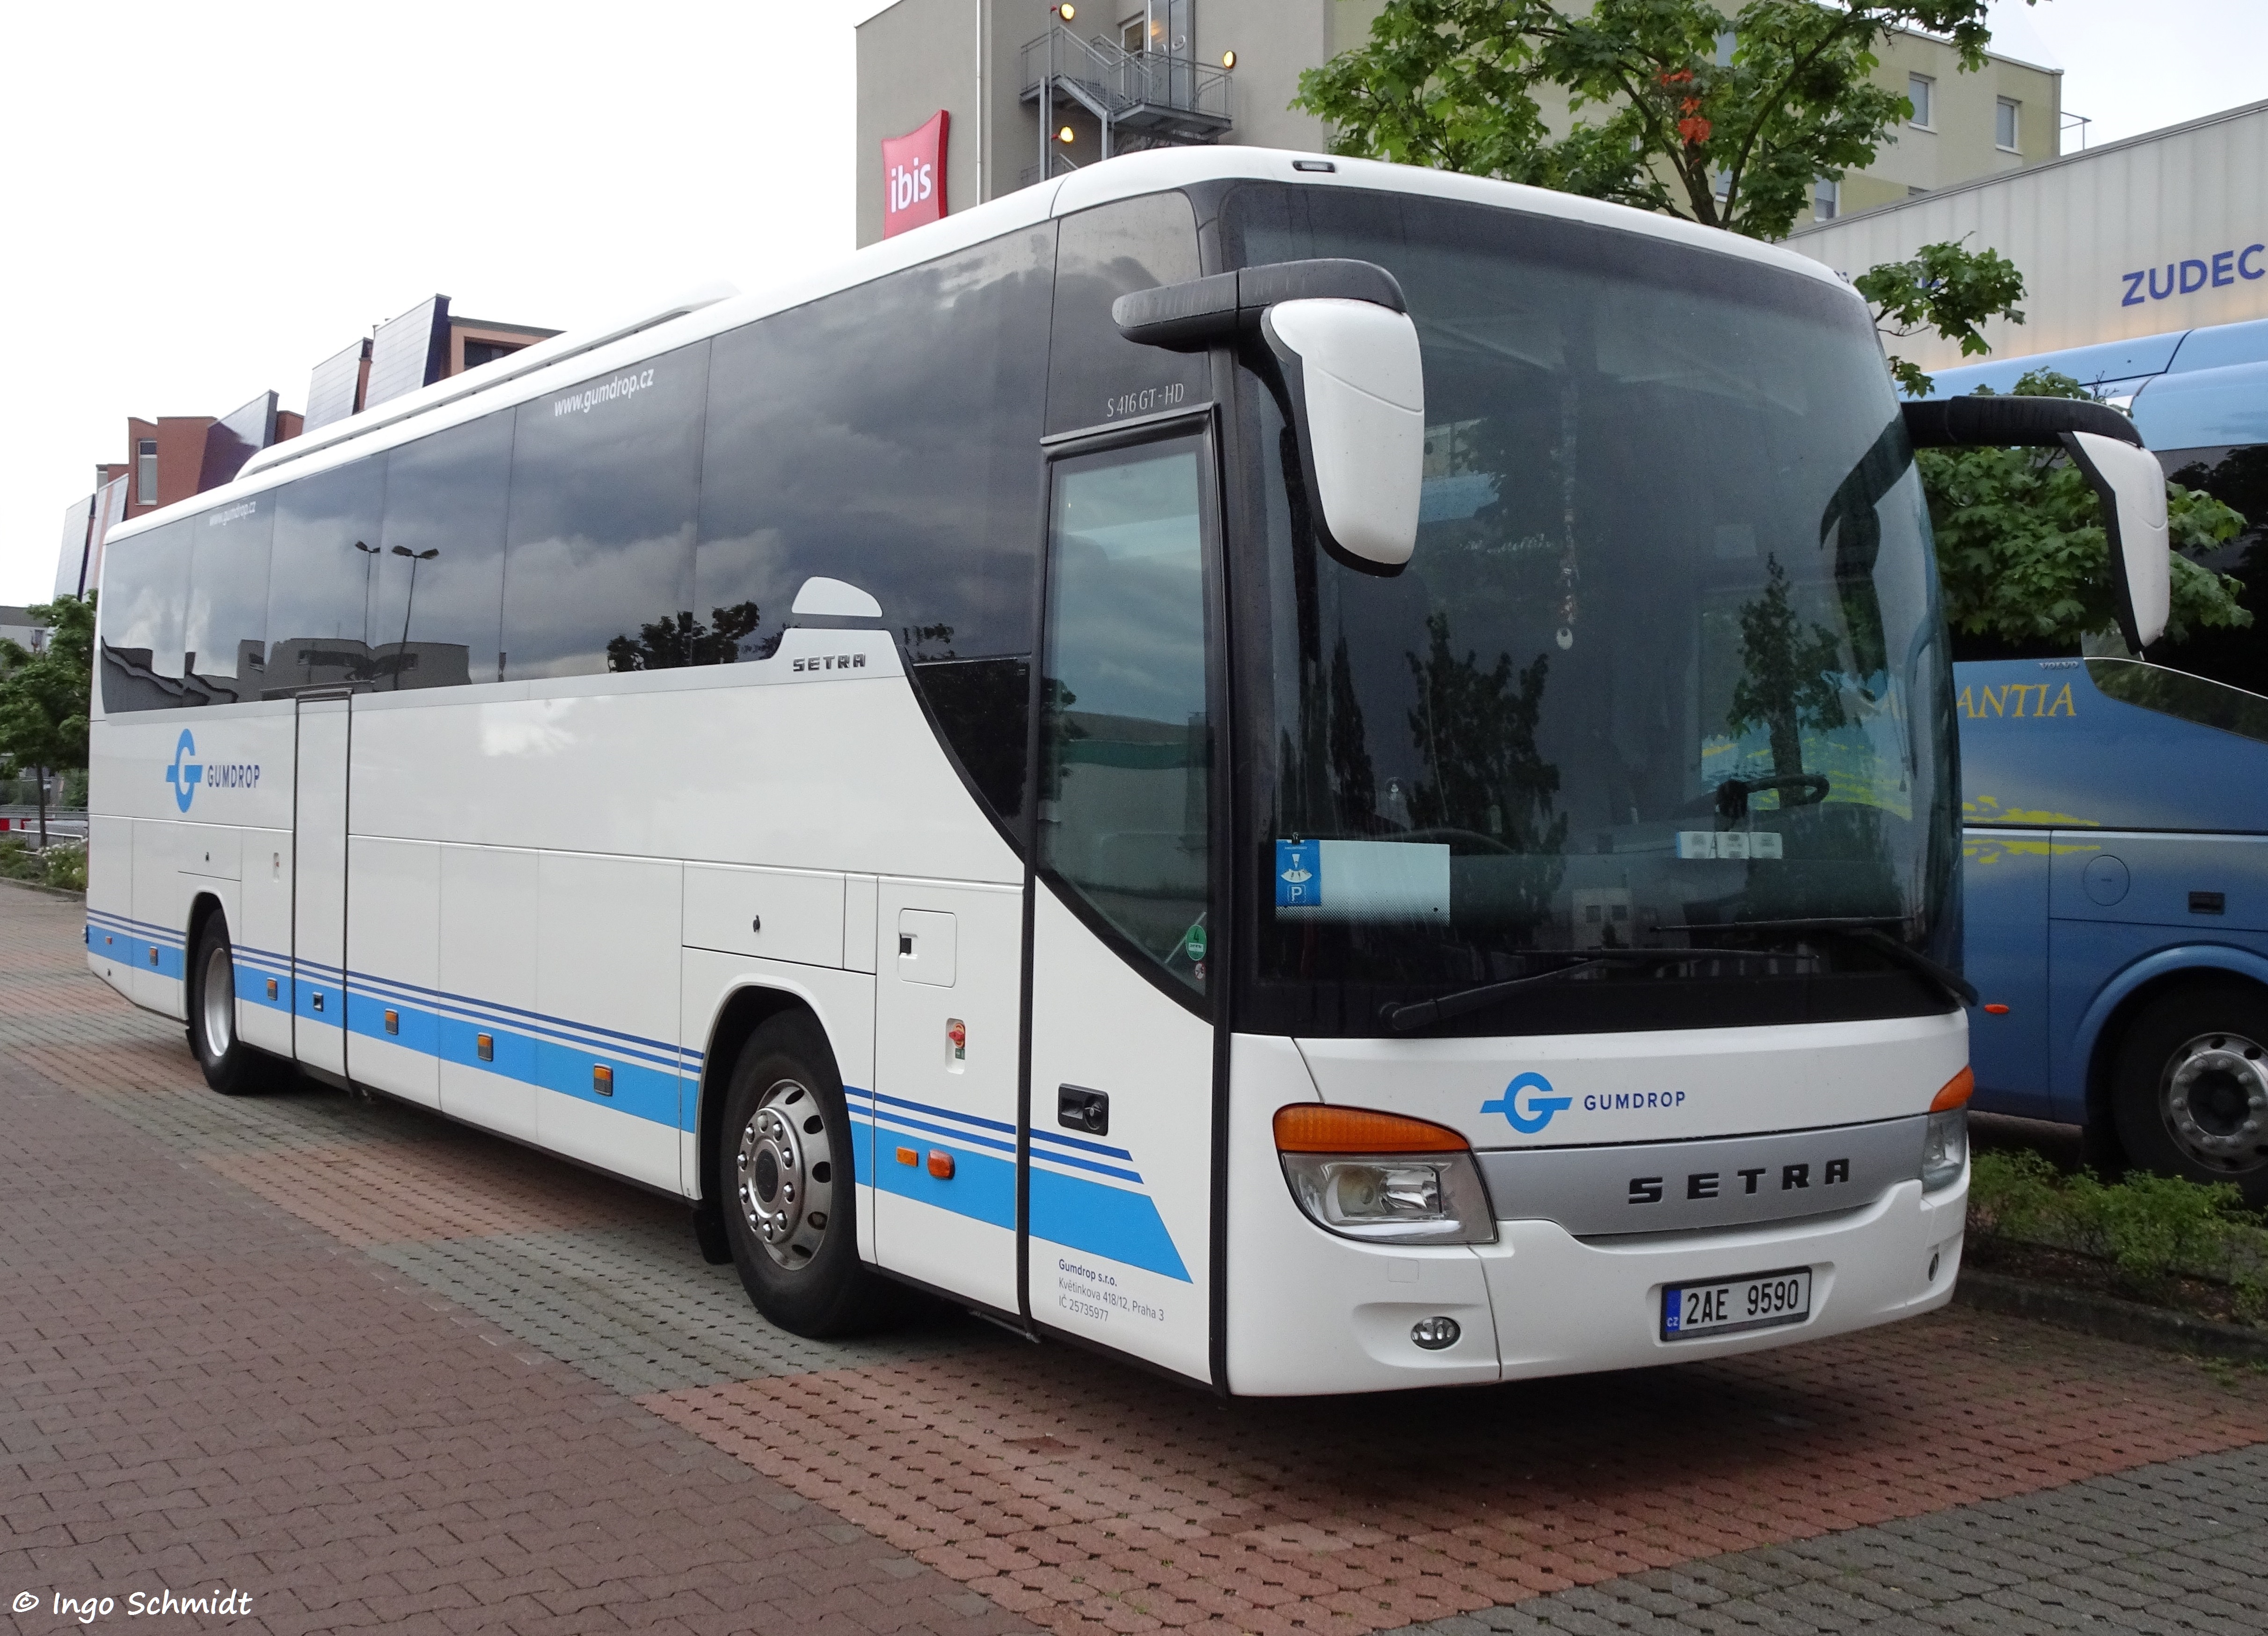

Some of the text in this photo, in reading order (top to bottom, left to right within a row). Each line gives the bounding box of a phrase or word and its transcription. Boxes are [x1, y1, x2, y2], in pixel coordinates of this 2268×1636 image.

[891, 157, 932, 213] ibis
[2122, 244, 2266, 307] ZUDEC
[554, 368, 654, 416] www.gumdrop.cz
[793, 653, 866, 672] SETRA
[207, 764, 260, 788] GUMDROP
[1291, 886, 1302, 902] P
[1583, 1091, 1686, 1111] GUMDROP
[1628, 1158, 1850, 1205] SETRA
[1058, 1259, 1118, 1287] Gumdrop s.r.o.
[1058, 1277, 1165, 1321] Květinkova 418/12, Praha 3
[1069, 1298, 1108, 1322] 25735977
[1686, 1279, 1799, 1325] 2AE 9590
[1667, 1317, 1678, 1327] CZ
